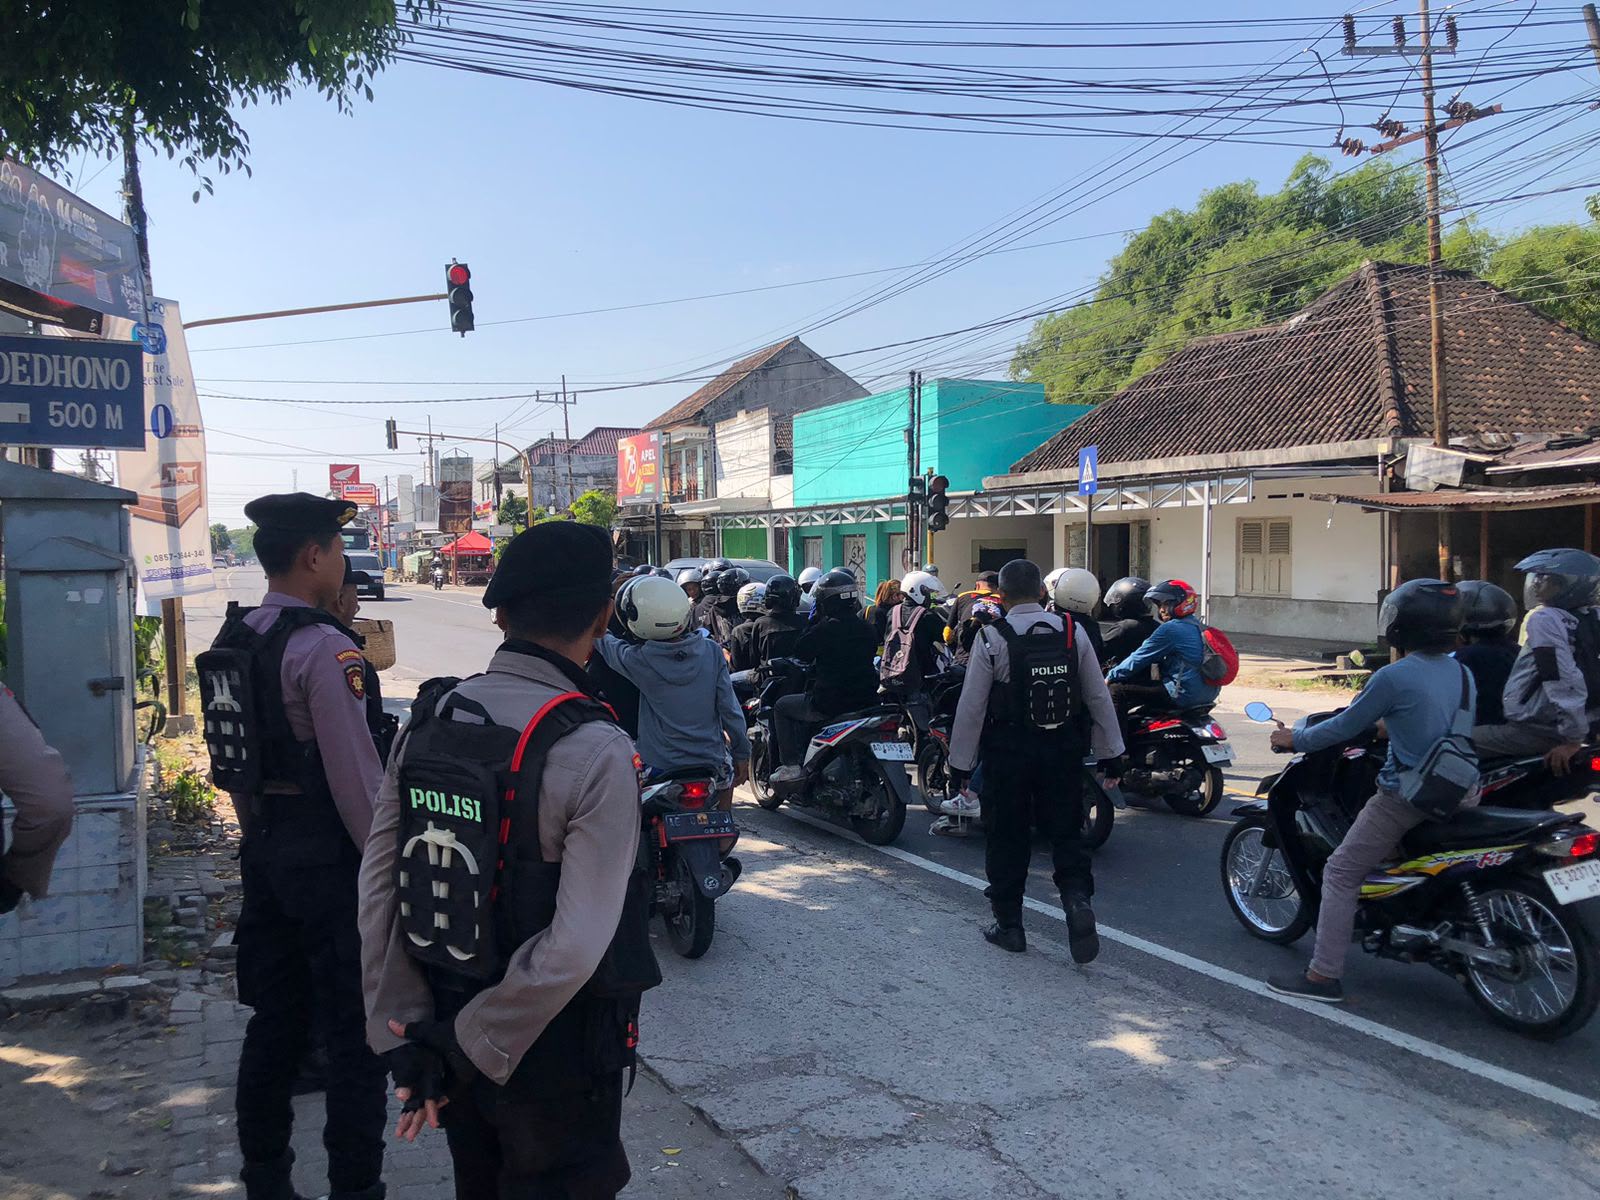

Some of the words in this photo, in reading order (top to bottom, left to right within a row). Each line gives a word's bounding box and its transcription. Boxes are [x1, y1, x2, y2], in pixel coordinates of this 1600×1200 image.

[146, 361, 165, 374] The
[48, 401, 98, 428] 500
[105, 403, 123, 430] M
[1031, 664, 1068, 676] POLISI
[409, 787, 482, 823] POLISI
